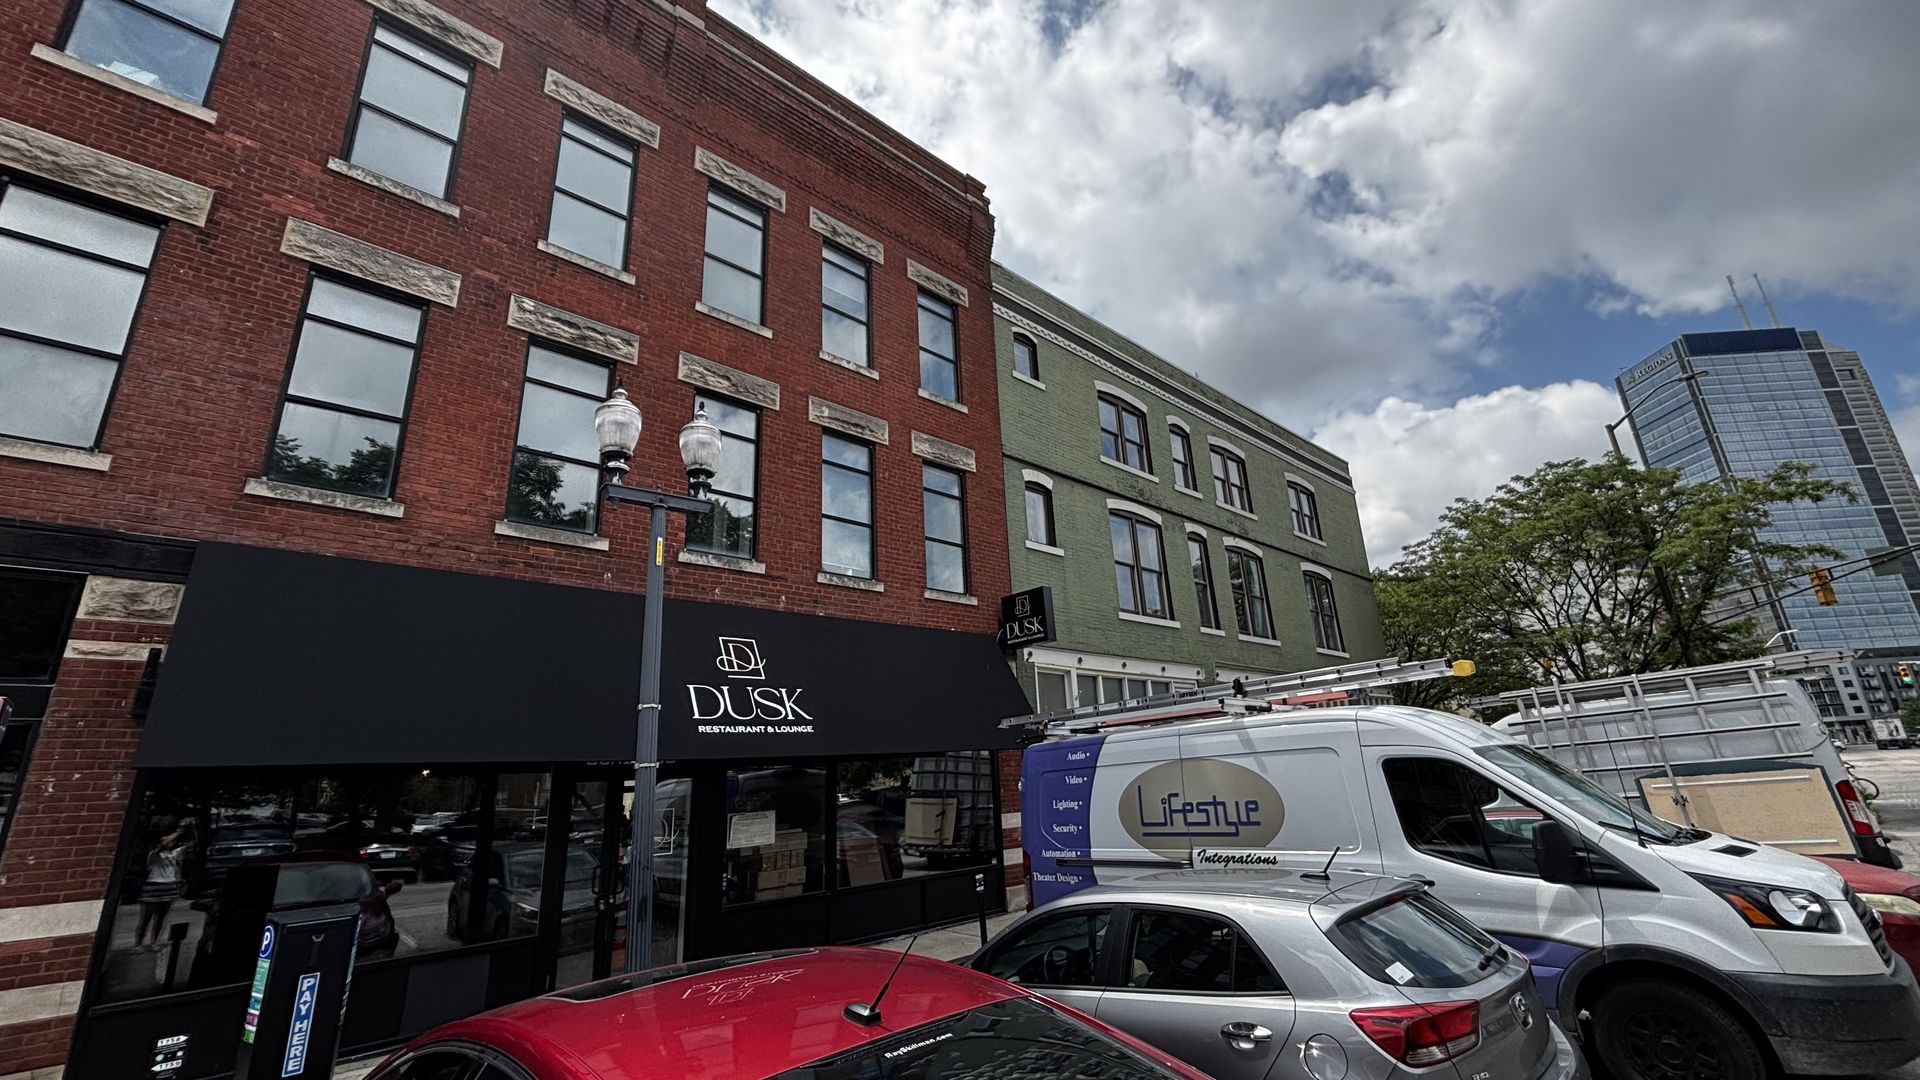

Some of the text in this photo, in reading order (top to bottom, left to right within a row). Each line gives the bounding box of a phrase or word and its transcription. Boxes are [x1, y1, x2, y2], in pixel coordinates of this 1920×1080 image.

[1634, 352, 1673, 379] REGIONS
[1006, 615, 1044, 639] DUSK
[686, 684, 813, 720] DUSK
[698, 725, 814, 733] RESTAURANT & LOUNGE
[1066, 751, 1086, 761] Audio
[1065, 775, 1083, 785] Video
[1052, 800, 1079, 811] Lighting
[1052, 823, 1078, 834] Security
[1041, 848, 1076, 858] Automation
[1197, 849, 1279, 868] Integrations
[1032, 872, 1079, 885] Theater Design
[287, 977, 316, 1072] PAY HERE
[884, 1032, 954, 1059] RaySkillman.com
